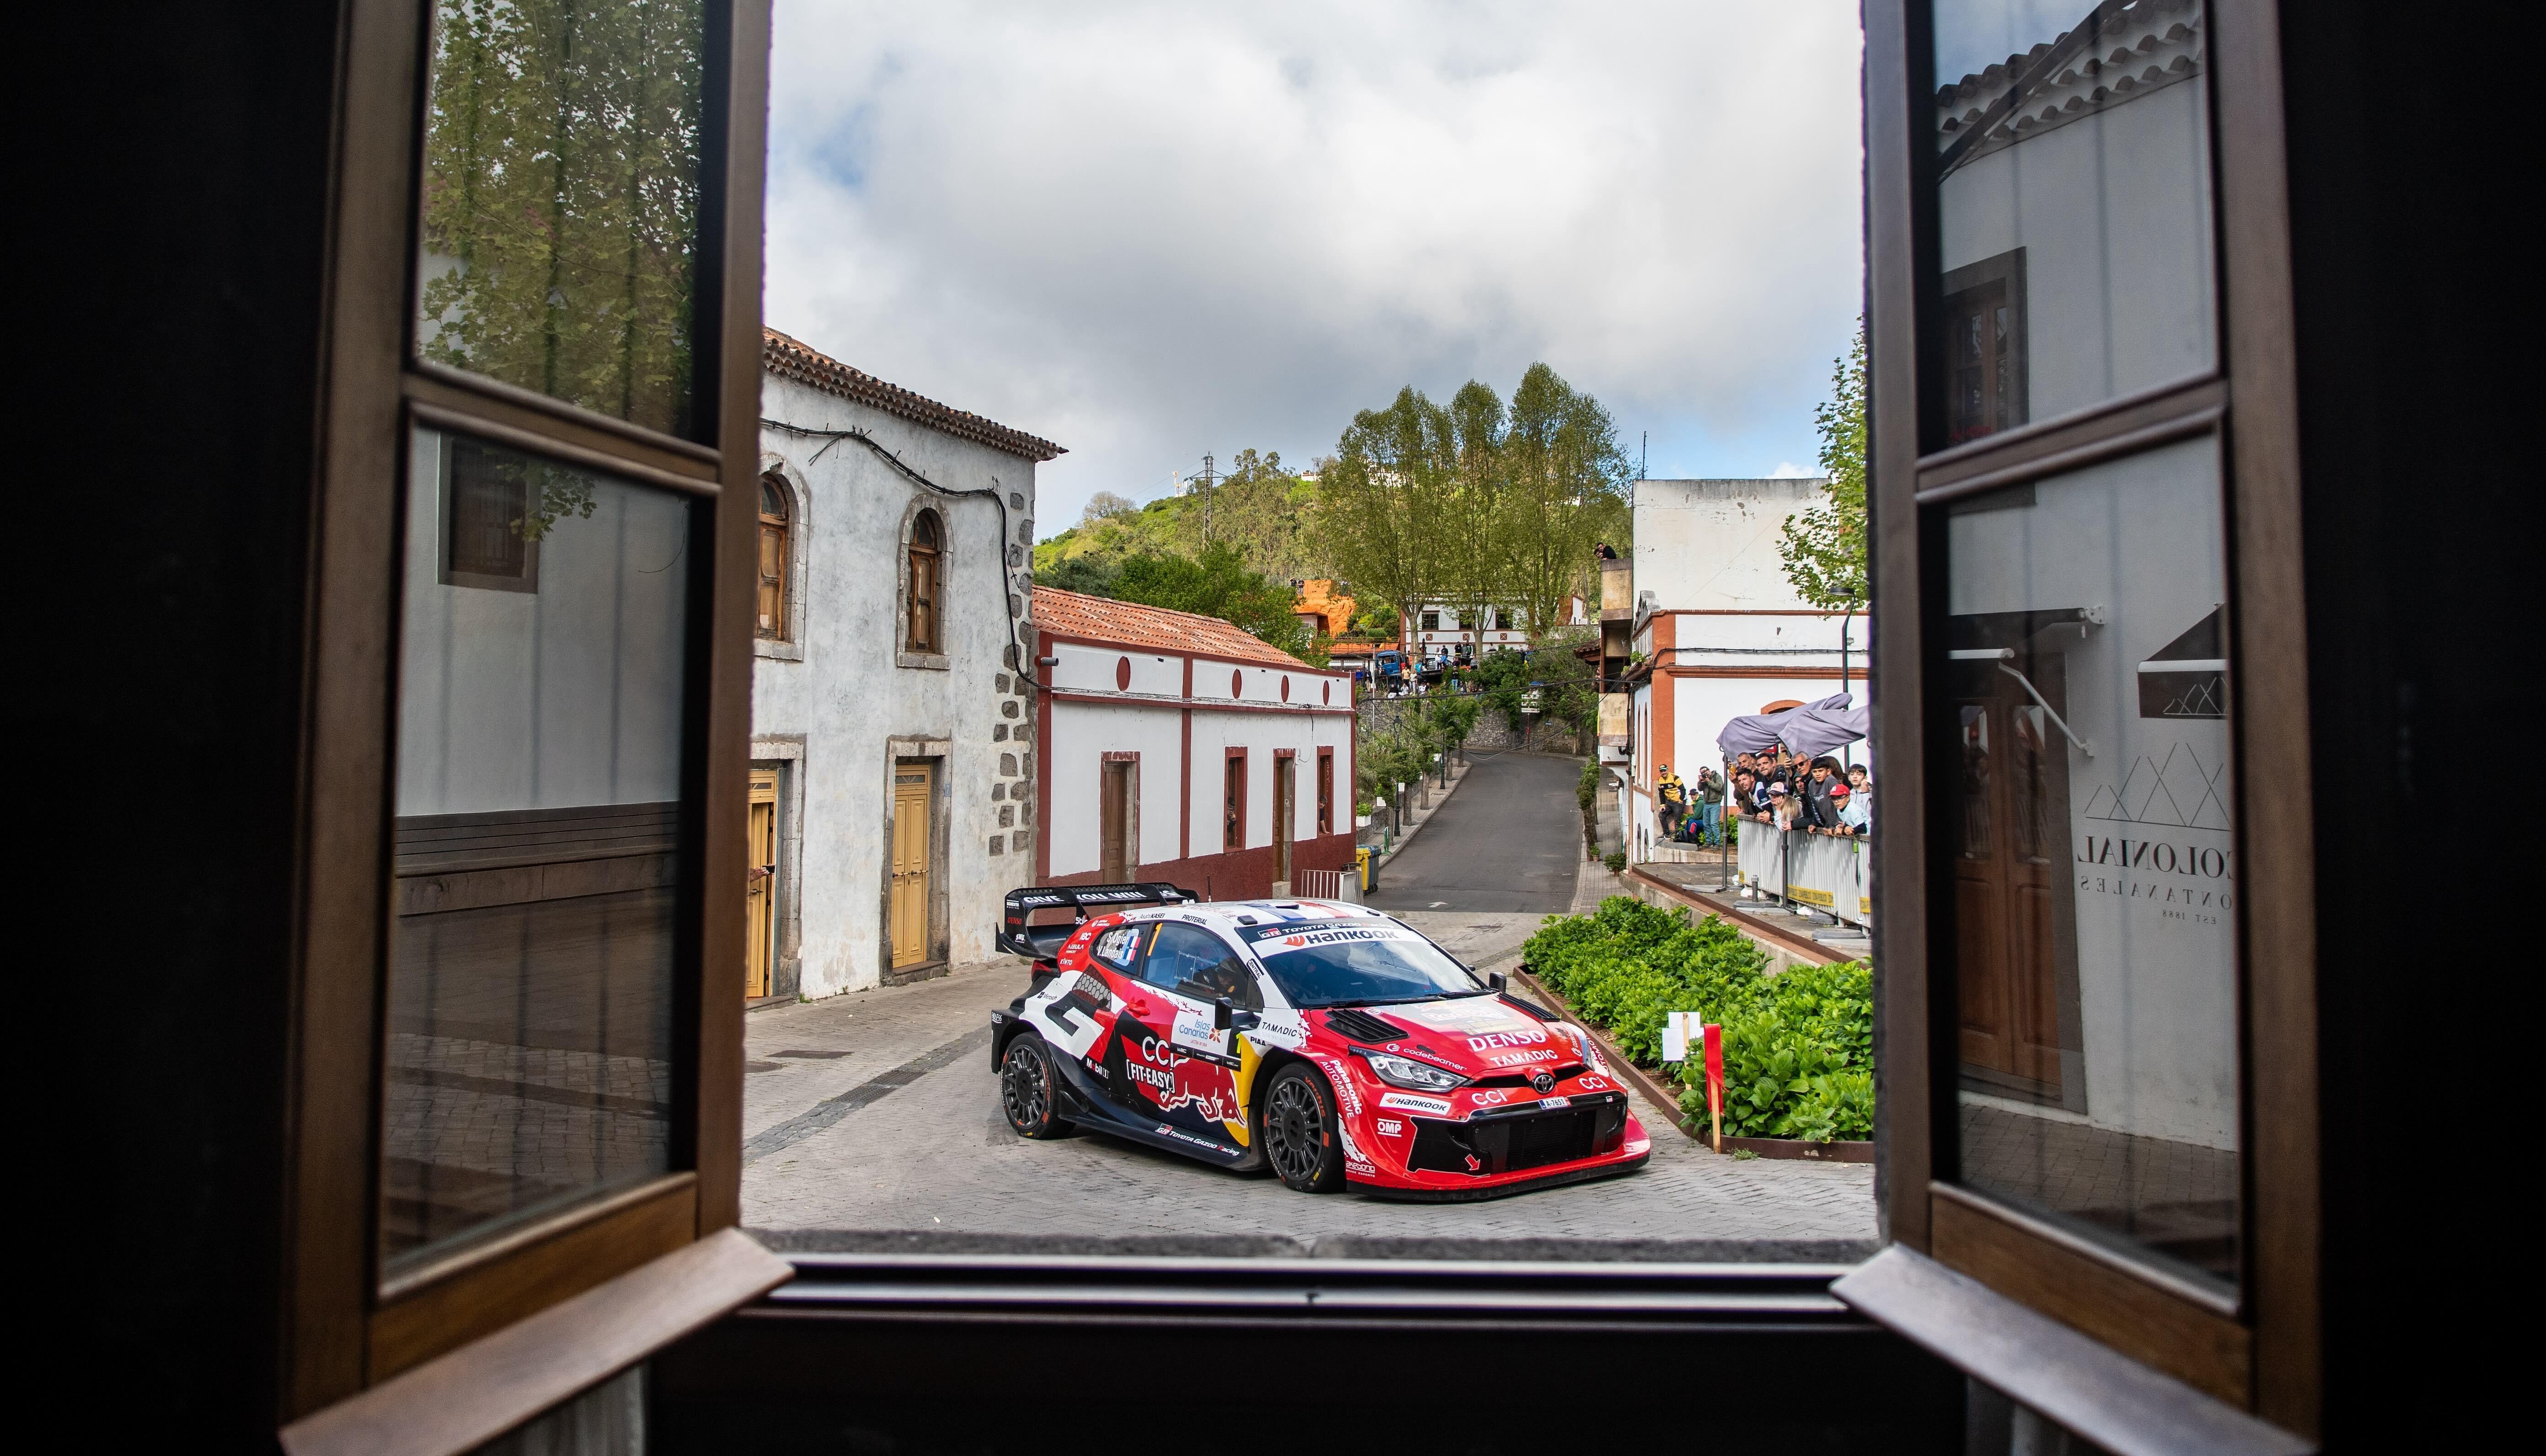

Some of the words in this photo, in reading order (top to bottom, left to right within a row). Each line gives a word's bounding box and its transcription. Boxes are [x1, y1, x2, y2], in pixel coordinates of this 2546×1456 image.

[1007, 916, 1022, 925] DENSO
[1182, 914, 1208, 925] PROTERIAL
[1282, 924, 1325, 933] TOYOTA
[1147, 923, 1163, 956] 1
[1247, 959, 1261, 979] CENTRAL
[1179, 1024, 1209, 1040] Canarias
[1194, 1019, 1211, 1031] Islas
[1262, 1021, 1297, 1037] TAMADIC
[1250, 1036, 1266, 1046] PIAA
[1466, 1030, 1546, 1052] DENSO
[1086, 1057, 1102, 1075] Mobil
[1403, 1047, 1465, 1071] codebeamer
[1489, 1049, 1558, 1067] TAMADIC
[1320, 1061, 1354, 1118] AUTOMOTIVE
[1329, 1059, 1363, 1115] Panasonic
[1546, 1099, 1565, 1107] A-7651
[1377, 1121, 1402, 1134] OMP
[1169, 1131, 1194, 1142] TOYOTA
[1193, 1138, 1218, 1149] GAZOO
[1217, 1144, 1240, 1156] Racing
